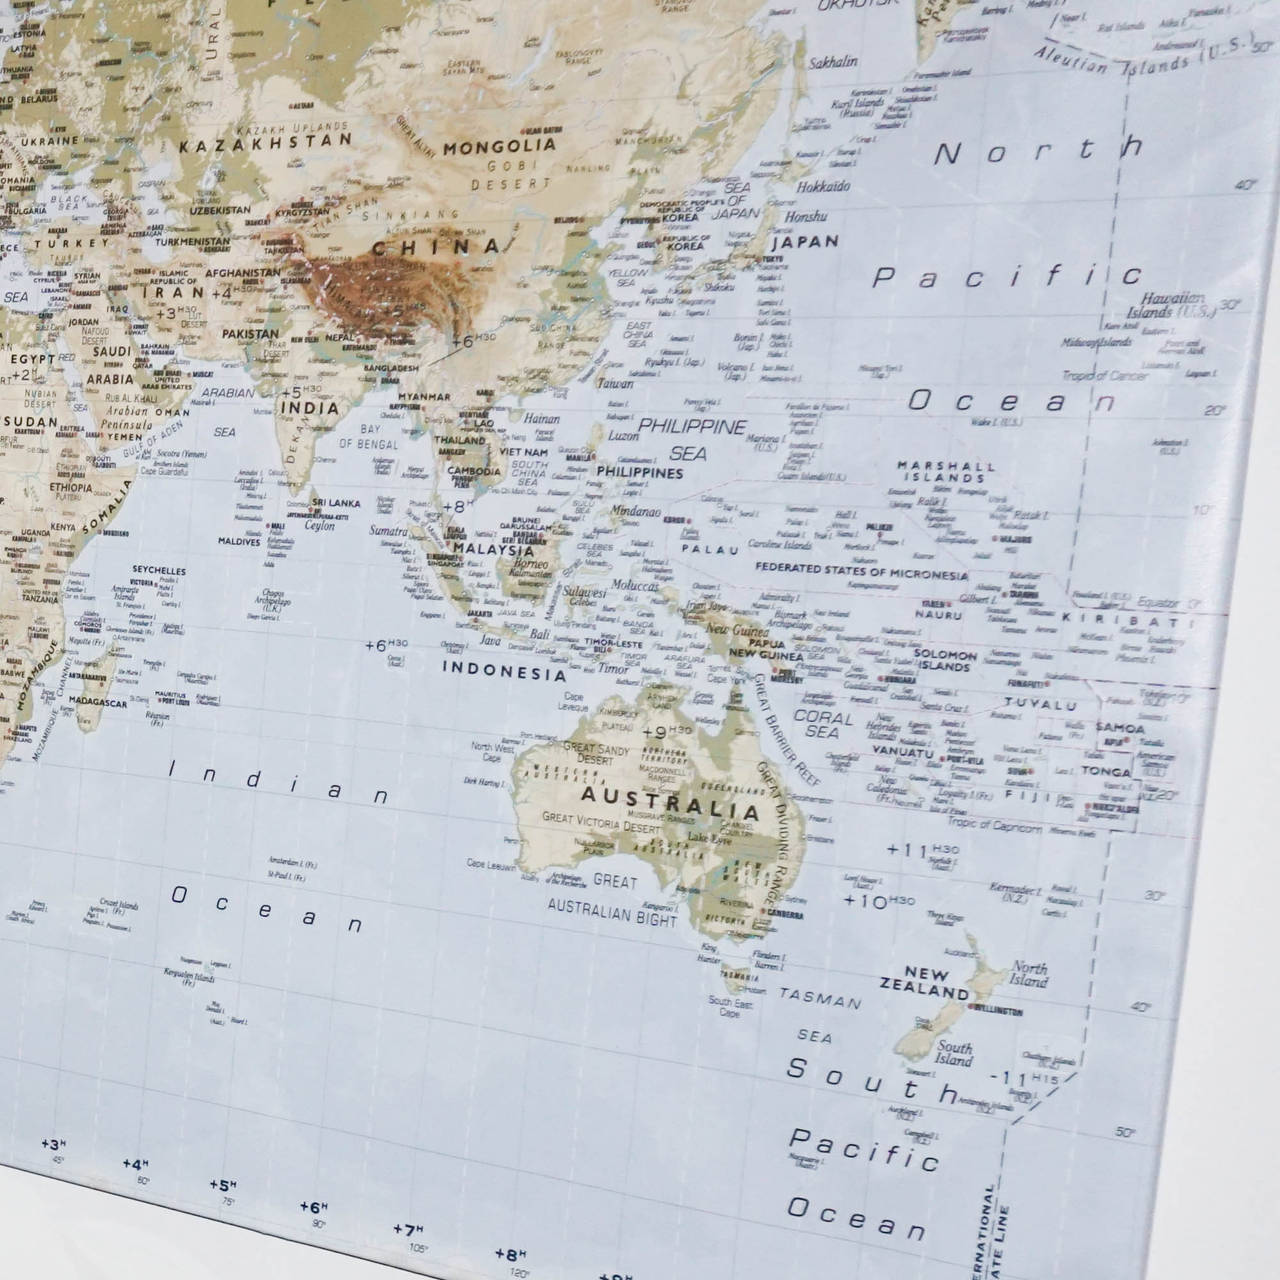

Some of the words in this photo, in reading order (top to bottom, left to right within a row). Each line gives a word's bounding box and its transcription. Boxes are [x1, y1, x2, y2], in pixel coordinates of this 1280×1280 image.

[809, 56, 857, 69] Sakhalin
[21, 136, 78, 146] UKRAINE
[179, 133, 353, 154] KAZAKHSTAN
[443, 138, 556, 155] MONGOLIA
[934, 134, 1143, 165] North
[35, 238, 109, 249] TURKEY
[156, 237, 230, 248] TURKMENISTAN
[371, 239, 499, 256] CHINA
[770, 235, 839, 249] JAPAN
[205, 268, 281, 278] AFGHANISTAN
[873, 264, 1142, 288] Pacific
[4, 292, 28, 303] SEA
[143, 287, 204, 300] IRAN
[222, 329, 279, 339] PAKISTAN
[11, 354, 55, 364] EGYPT
[93, 347, 131, 357] SAUDI
[87, 375, 134, 384] ARABIA
[201, 388, 254, 399] ARABIAN
[909, 389, 1116, 411] Ocean
[281, 401, 340, 415] INDIA
[4, 416, 58, 428] SUDAN
[639, 417, 746, 436] PHILIPPINE
[214, 427, 235, 437] SEA
[435, 436, 485, 445] THAILAND
[670, 445, 706, 461] SEA
[597, 466, 683, 480] PHILIPPINES
[898, 461, 996, 472] MARSHALL
[905, 472, 985, 484] ISLANDS
[82, 479, 131, 535] SOMALIA
[370, 525, 408, 538] Sumatra
[454, 544, 534, 556] MALAYSIA
[756, 562, 821, 575] FEDERATED
[825, 566, 866, 577] STATES
[870, 568, 883, 577] OF
[889, 569, 969, 581] MICRONESIA
[914, 649, 977, 661] SOLOMON
[442, 662, 567, 683] INDONESIA
[918, 661, 970, 672] ISLANDS
[17, 640, 58, 711] MOZAMBIQUE
[69, 696, 127, 709] MADAGASCAR
[794, 709, 854, 726] CORAL
[806, 725, 840, 739] SEA
[1082, 766, 1130, 778] TONGA
[168, 760, 389, 805] Indian
[581, 787, 759, 822] AUSTRALIA
[594, 873, 637, 890] GREAT
[171, 885, 363, 934] Ocean
[548, 898, 631, 922] AUSTRALIAN
[637, 911, 677, 928] BIGHT
[906, 966, 949, 981] NEW
[1012, 960, 1048, 976] North
[880, 977, 969, 1001] ZEALAND
[1010, 974, 1048, 989] Island
[780, 987, 862, 1009] TASMAN
[798, 1030, 832, 1044] SEA
[938, 1040, 973, 1055] South
[936, 1053, 974, 1068] Island
[787, 1057, 957, 1105] South
[790, 1128, 940, 1173] Pacific
[788, 1196, 925, 1240] Ocean
[994, 1205, 1010, 1243] LINE
